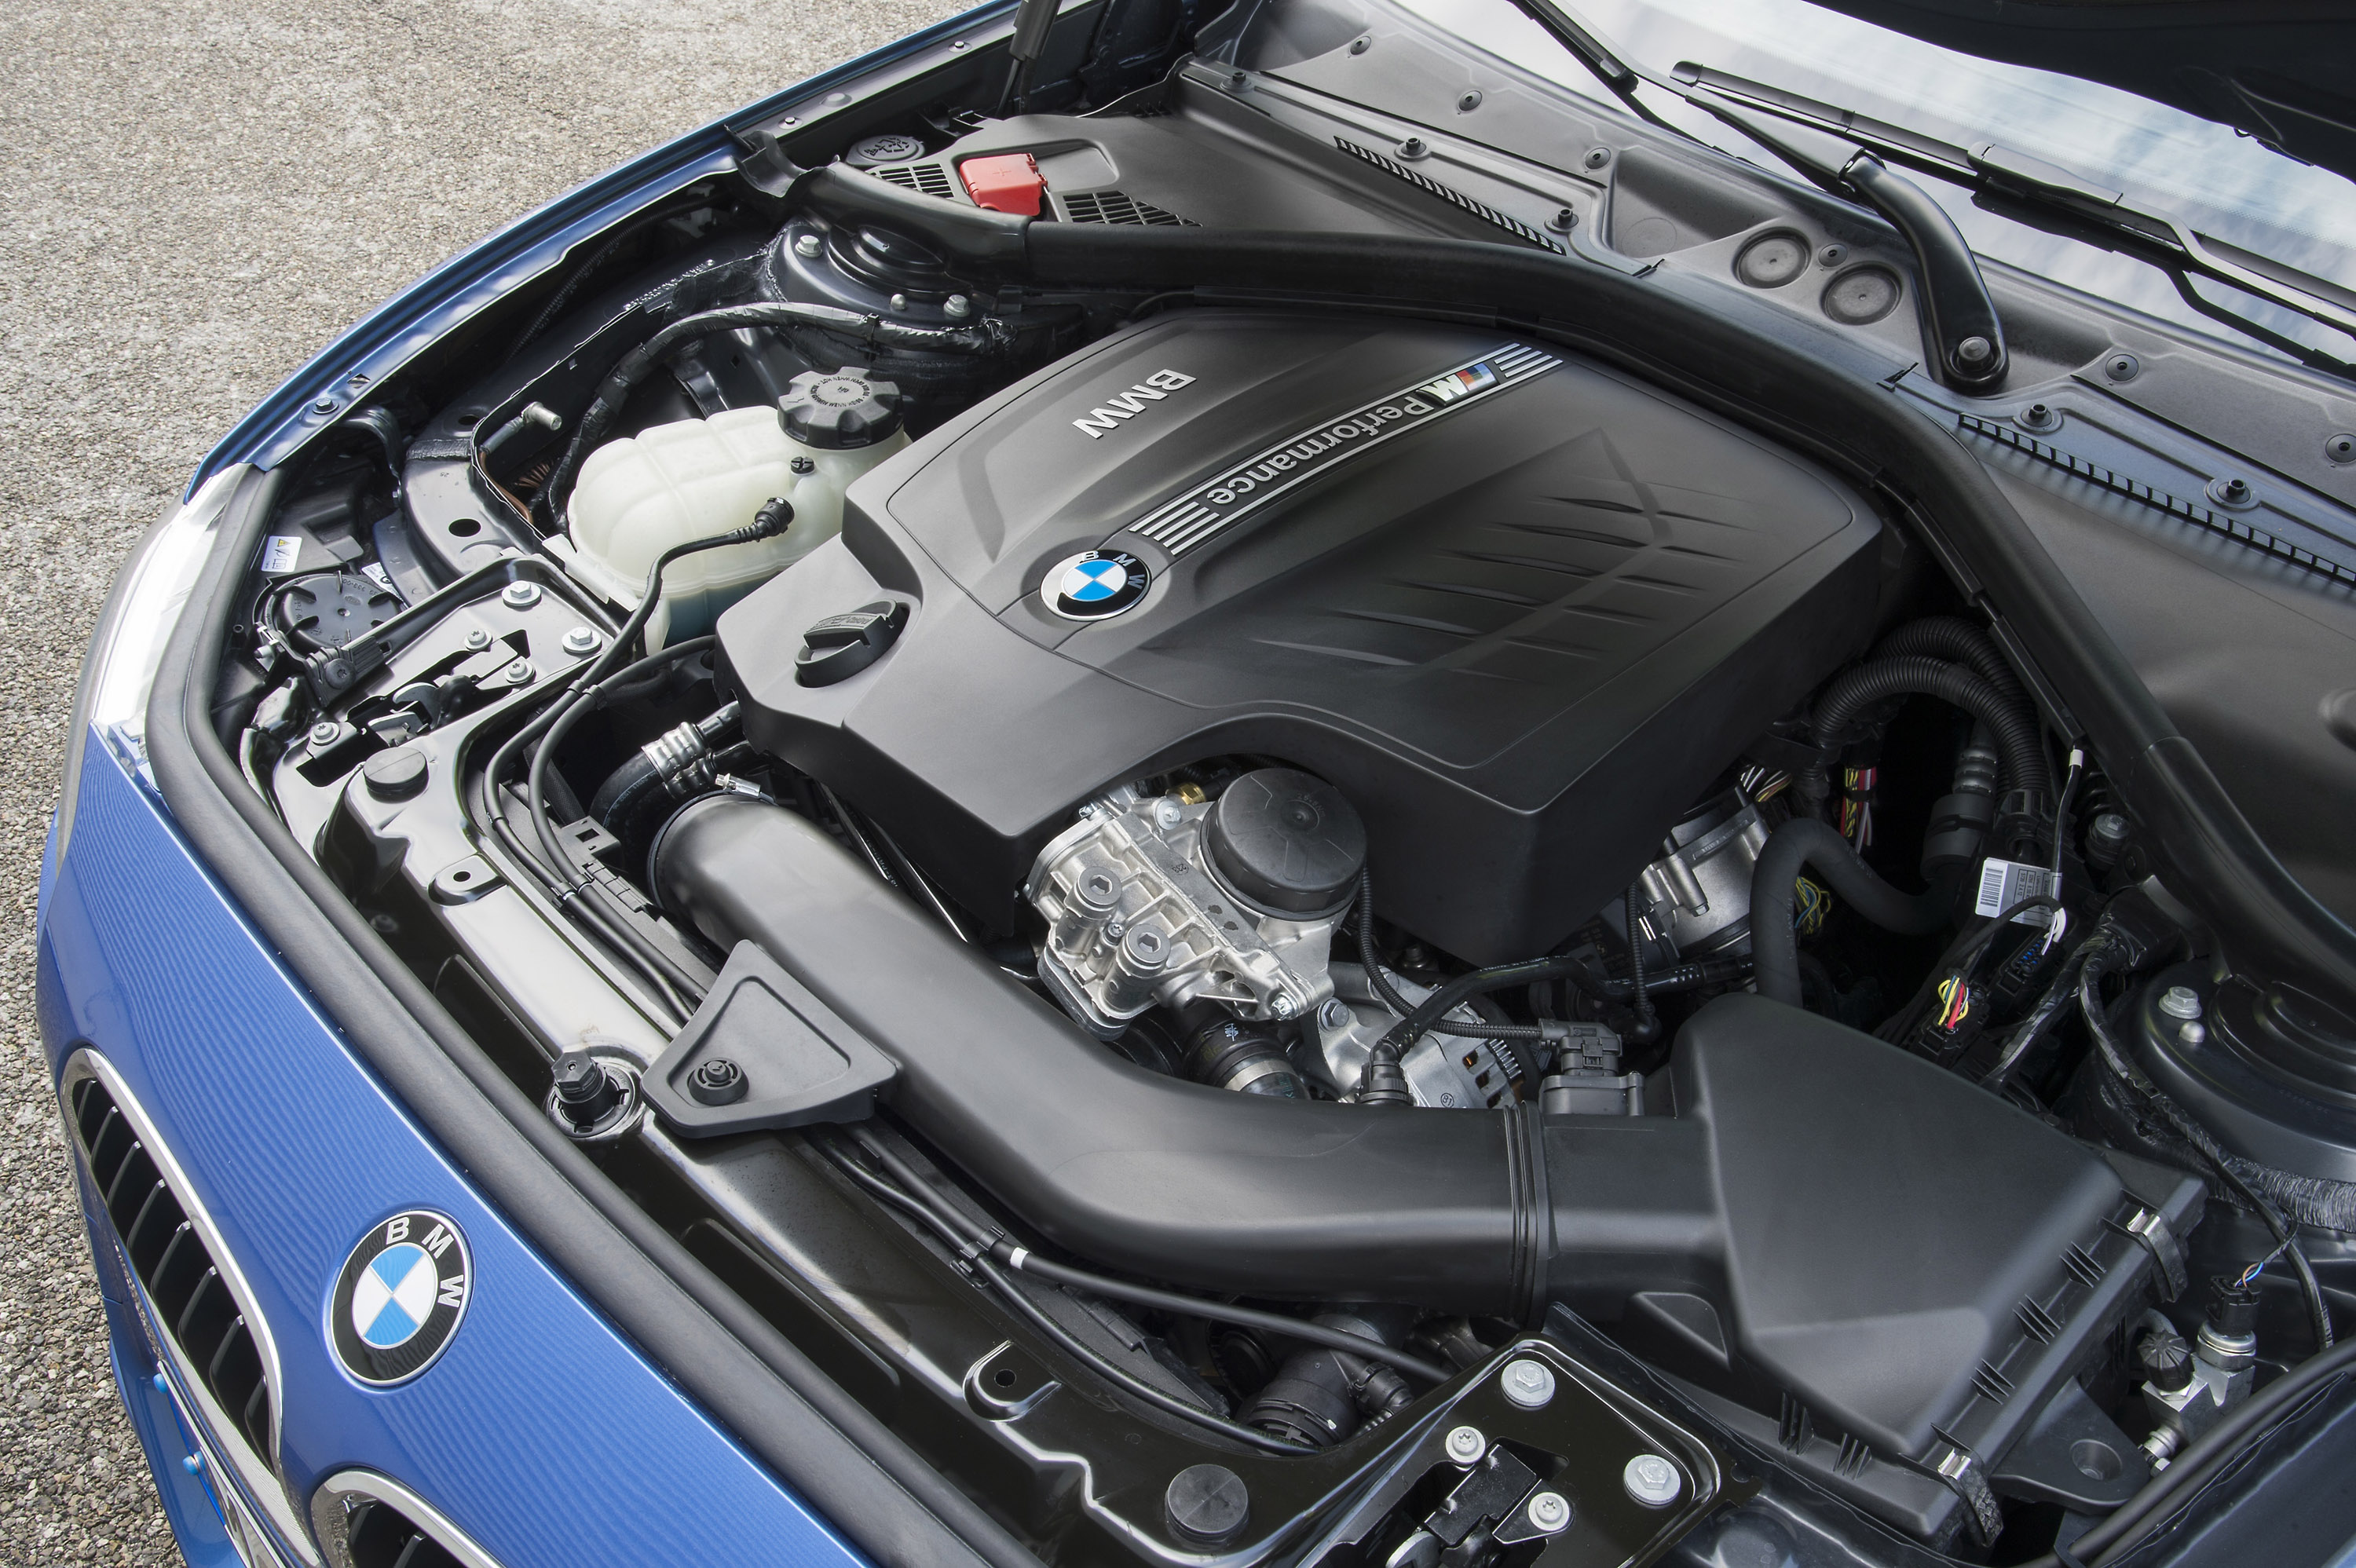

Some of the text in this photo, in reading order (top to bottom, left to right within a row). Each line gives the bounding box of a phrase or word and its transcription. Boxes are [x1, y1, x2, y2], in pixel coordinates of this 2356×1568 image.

[1073, 369, 1197, 440] BMW
[1207, 395, 1435, 506] Performance
[1080, 550, 1146, 590] BMW
[386, 1216, 464, 1308] BMW
